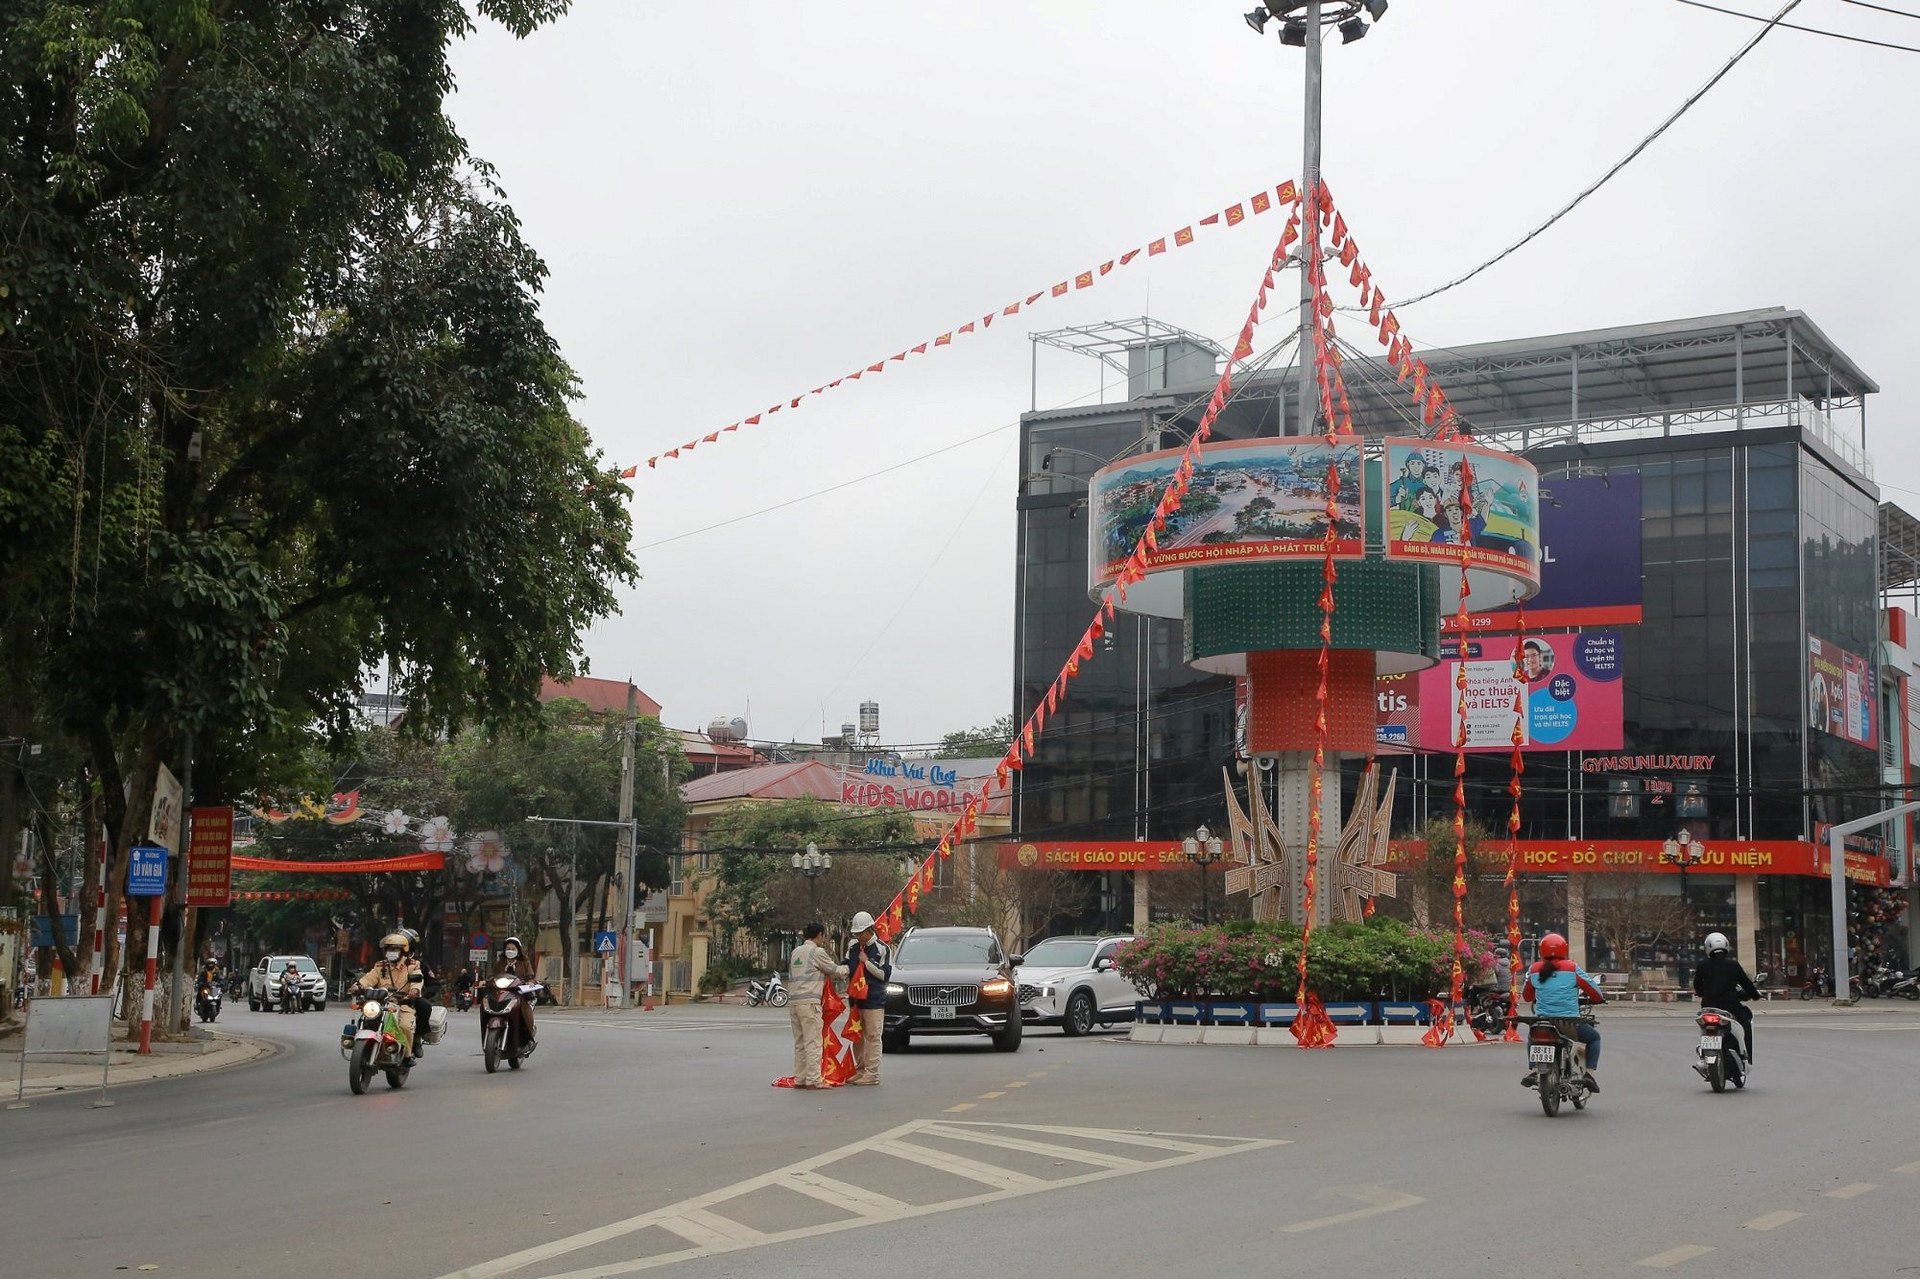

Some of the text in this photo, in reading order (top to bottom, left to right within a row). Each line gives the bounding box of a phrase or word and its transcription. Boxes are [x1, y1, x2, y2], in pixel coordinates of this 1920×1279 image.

[1153, 553, 1177, 565] VỮNG
[1179, 549, 1204, 560] BƯỚC
[1206, 549, 1224, 558] HỘI
[1225, 545, 1254, 557] NHẬP
[1256, 543, 1272, 553] VÀ
[1272, 542, 1300, 553] PHÁT
[1472, 618, 1491, 626] 1299
[1587, 637, 1615, 647] Chuẩn bị
[1594, 647, 1606, 655] học
[1586, 656, 1605, 664] Luyện
[1594, 662, 1615, 670] IELTS?
[1482, 677, 1499, 686] tiếng
[1555, 679, 1570, 688] Đặc
[1465, 685, 1518, 699] học thuật
[1555, 689, 1570, 697] biệt
[1466, 699, 1510, 709] và IELTS
[1560, 713, 1572, 721] học
[864, 758, 957, 789] Khu Vui Chơi
[842, 781, 897, 809] KIDS
[1046, 849, 1080, 863] SÁCH
[1084, 848, 1116, 863] GIÁO
[1119, 851, 1147, 866] DỤC
[1525, 851, 1559, 867] HỌC
[1572, 844, 1597, 864] ĐỒ
[1603, 850, 1643, 864] CHƠI
[1731, 848, 1772, 868] NIỆM
[141, 862, 153, 877] VĂN
[153, 861, 163, 877] GIÁ
